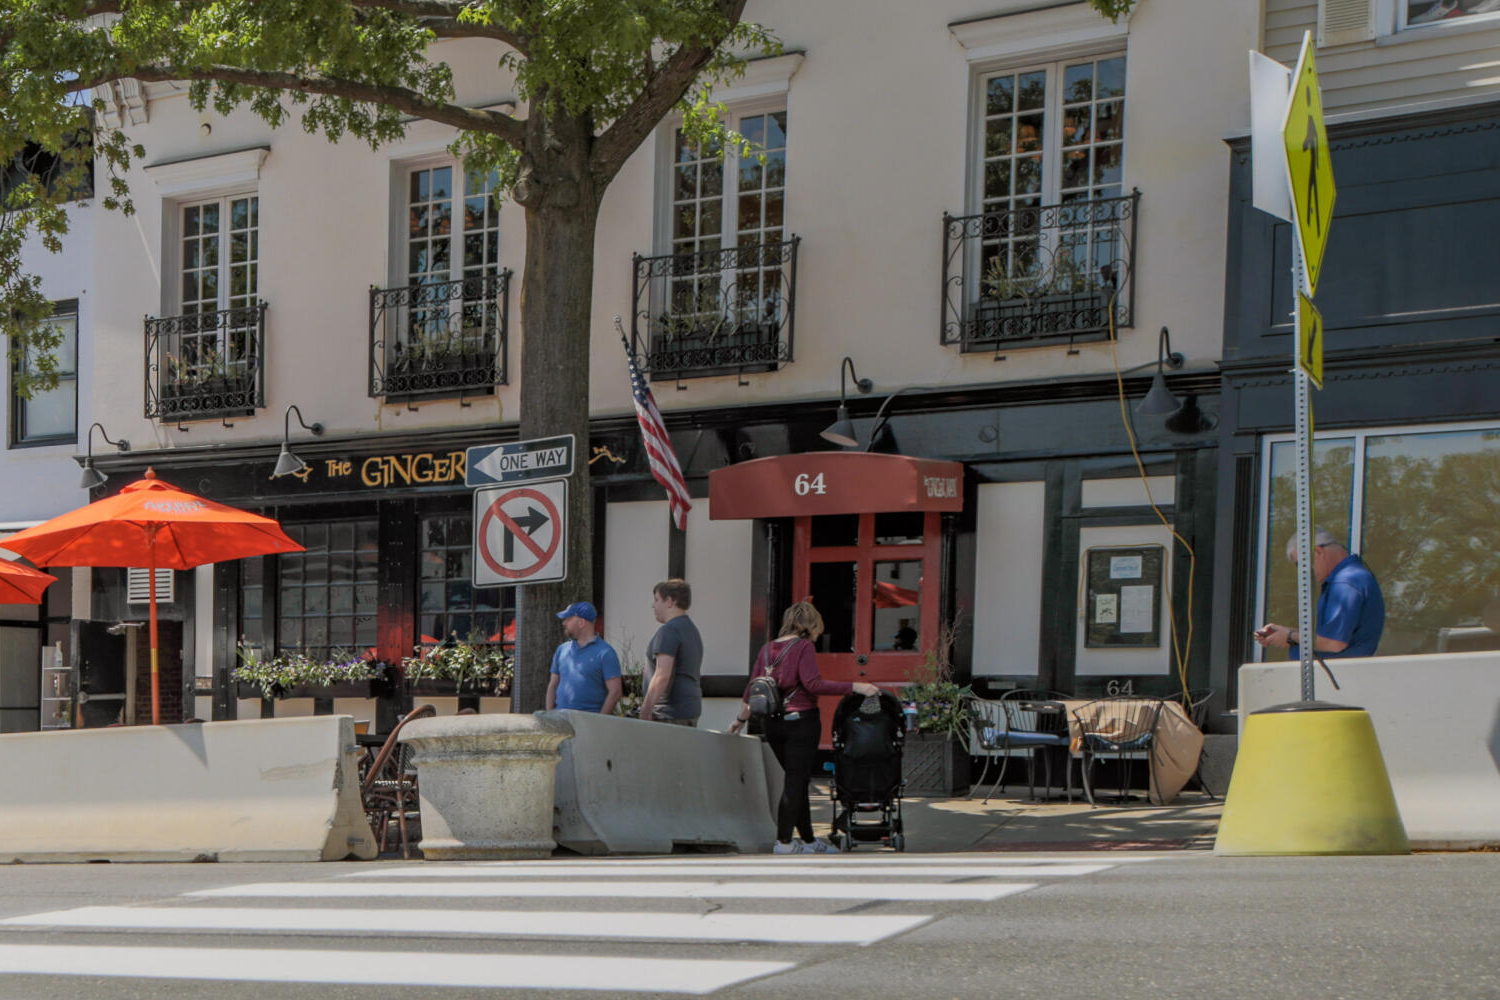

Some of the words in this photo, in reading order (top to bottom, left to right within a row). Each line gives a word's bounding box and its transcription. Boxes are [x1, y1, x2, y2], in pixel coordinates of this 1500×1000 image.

[500, 454, 529, 471] ONE
[535, 448, 565, 467] WAY
[794, 472, 827, 496] 64
[1106, 679, 1134, 697] 64
